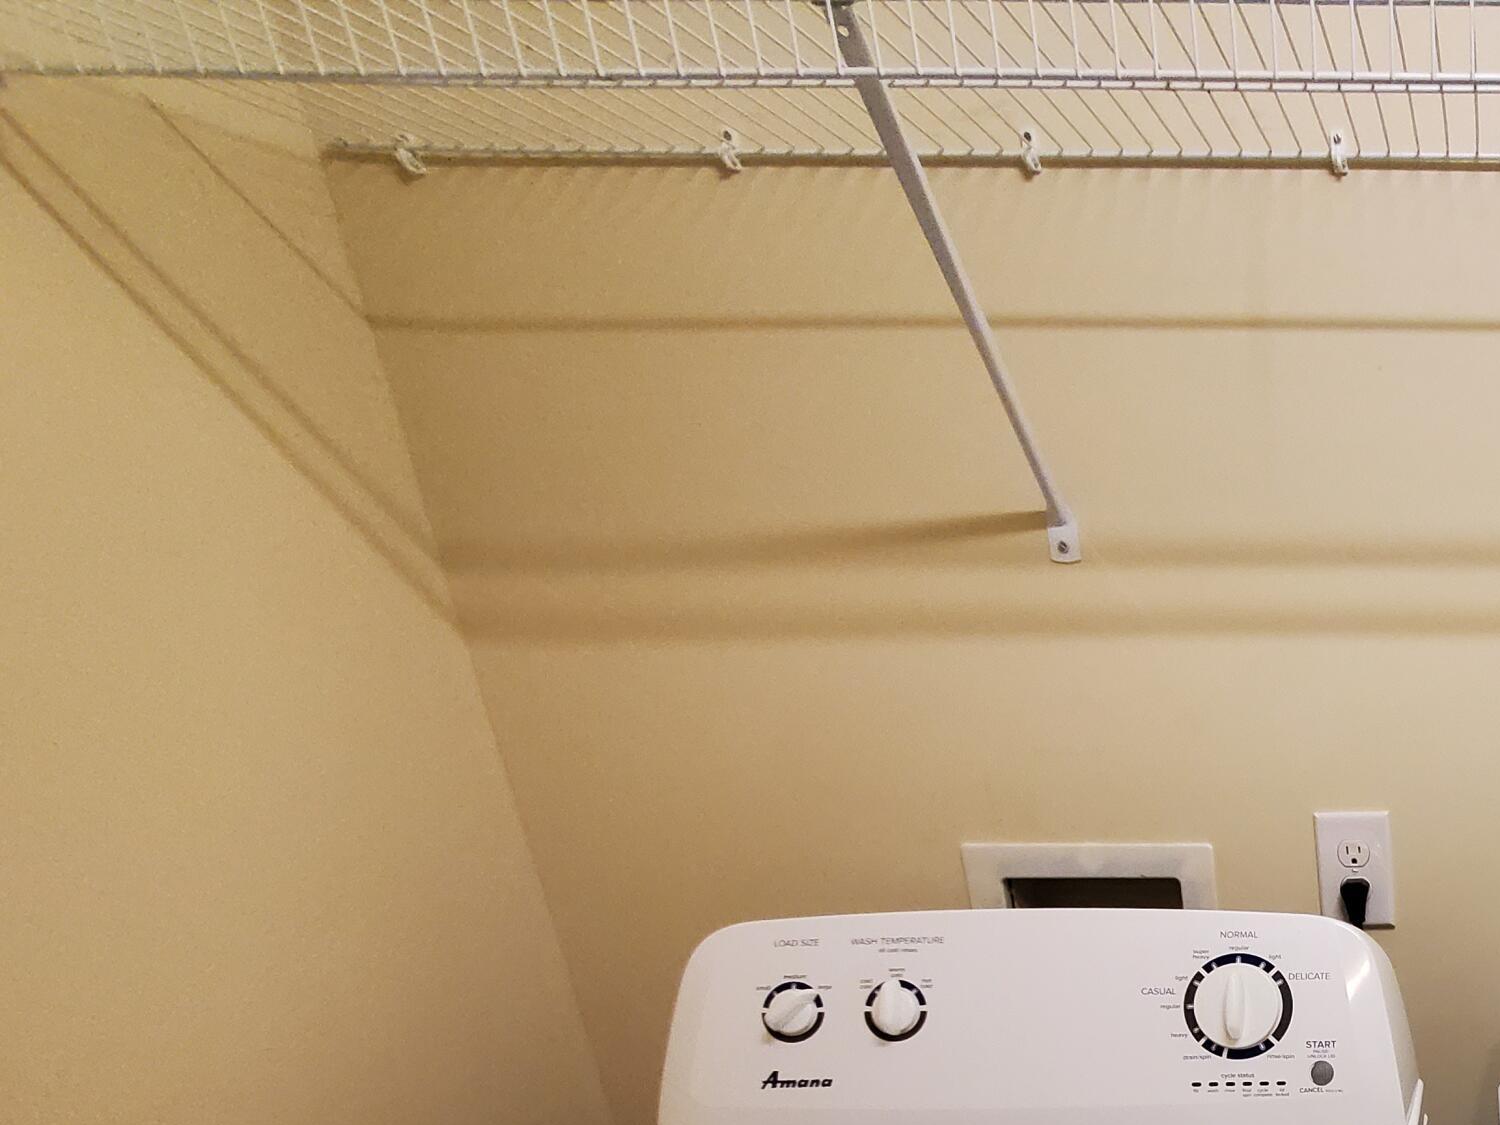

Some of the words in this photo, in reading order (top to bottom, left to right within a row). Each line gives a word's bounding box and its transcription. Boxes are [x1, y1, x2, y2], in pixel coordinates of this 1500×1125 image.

[1220, 931, 1258, 939] NORMAL
[774, 939, 798, 948] LOAD
[800, 938, 820, 947] SIZE
[851, 937, 878, 945] WASH
[880, 936, 945, 945] TEMPERATURE
[1288, 972, 1331, 981] DELICATE
[1141, 987, 1176, 996] CASUAL
[1305, 1040, 1336, 1049] START
[761, 1071, 833, 1089] Amana
